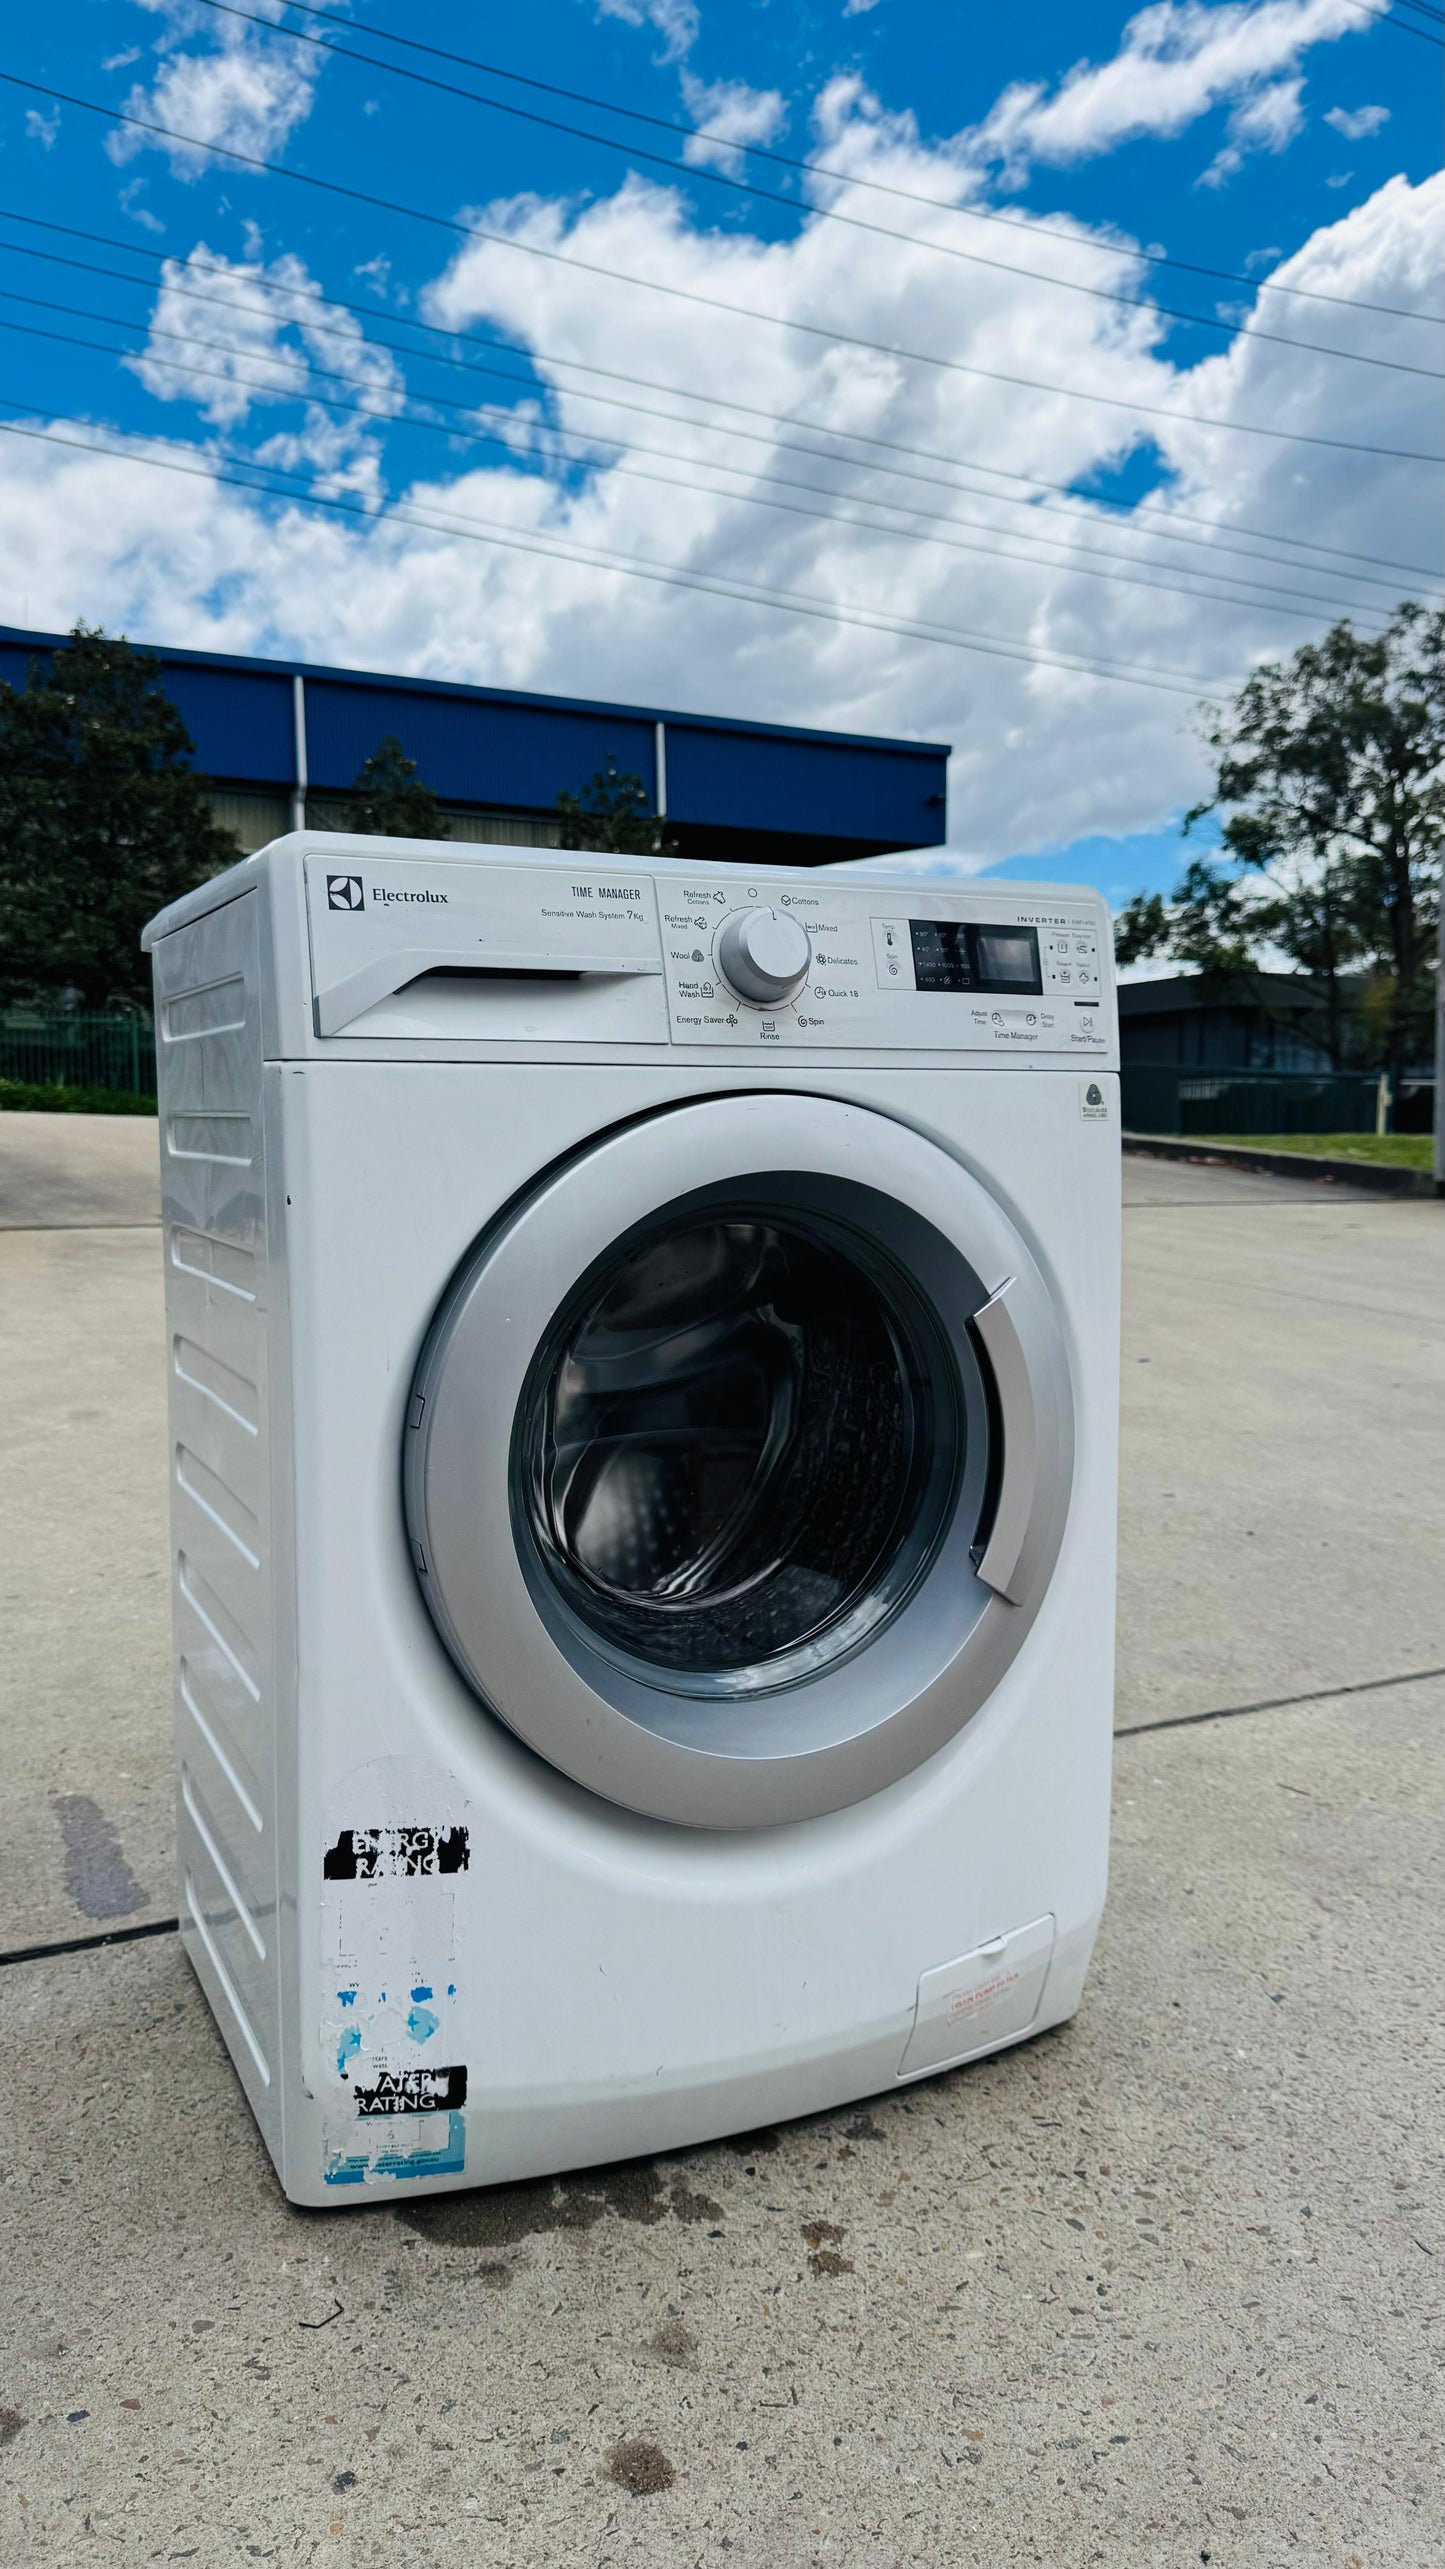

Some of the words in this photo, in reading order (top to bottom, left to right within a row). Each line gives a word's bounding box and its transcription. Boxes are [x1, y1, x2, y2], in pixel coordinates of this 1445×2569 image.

[372, 888, 449, 903] Electrolux
[571, 886, 593, 898] TIME
[598, 888, 641, 900] MANAGER
[683, 890, 711, 899] Refresh
[791, 897, 819, 905] Cottons
[541, 909, 574, 918] Sensitive
[598, 911, 625, 920] System
[664, 915, 693, 923] Refresh
[1017, 916, 1066, 924] INVERTER
[818, 924, 838, 932] Mixed
[670, 952, 690, 960] Wool
[827, 957, 858, 965] Delicates
[676, 1016, 702, 1025] Energy
[703, 1016, 724, 1024] Saver
[808, 1018, 824, 1026] Spin
[760, 1032, 780, 1040] Rinse
[994, 1031, 1009, 1039] Time
[1010, 1032, 1038, 1041] Manager
[1071, 1034, 1105, 1043] Start/Pause
[357, 2093, 435, 2112] RATING
